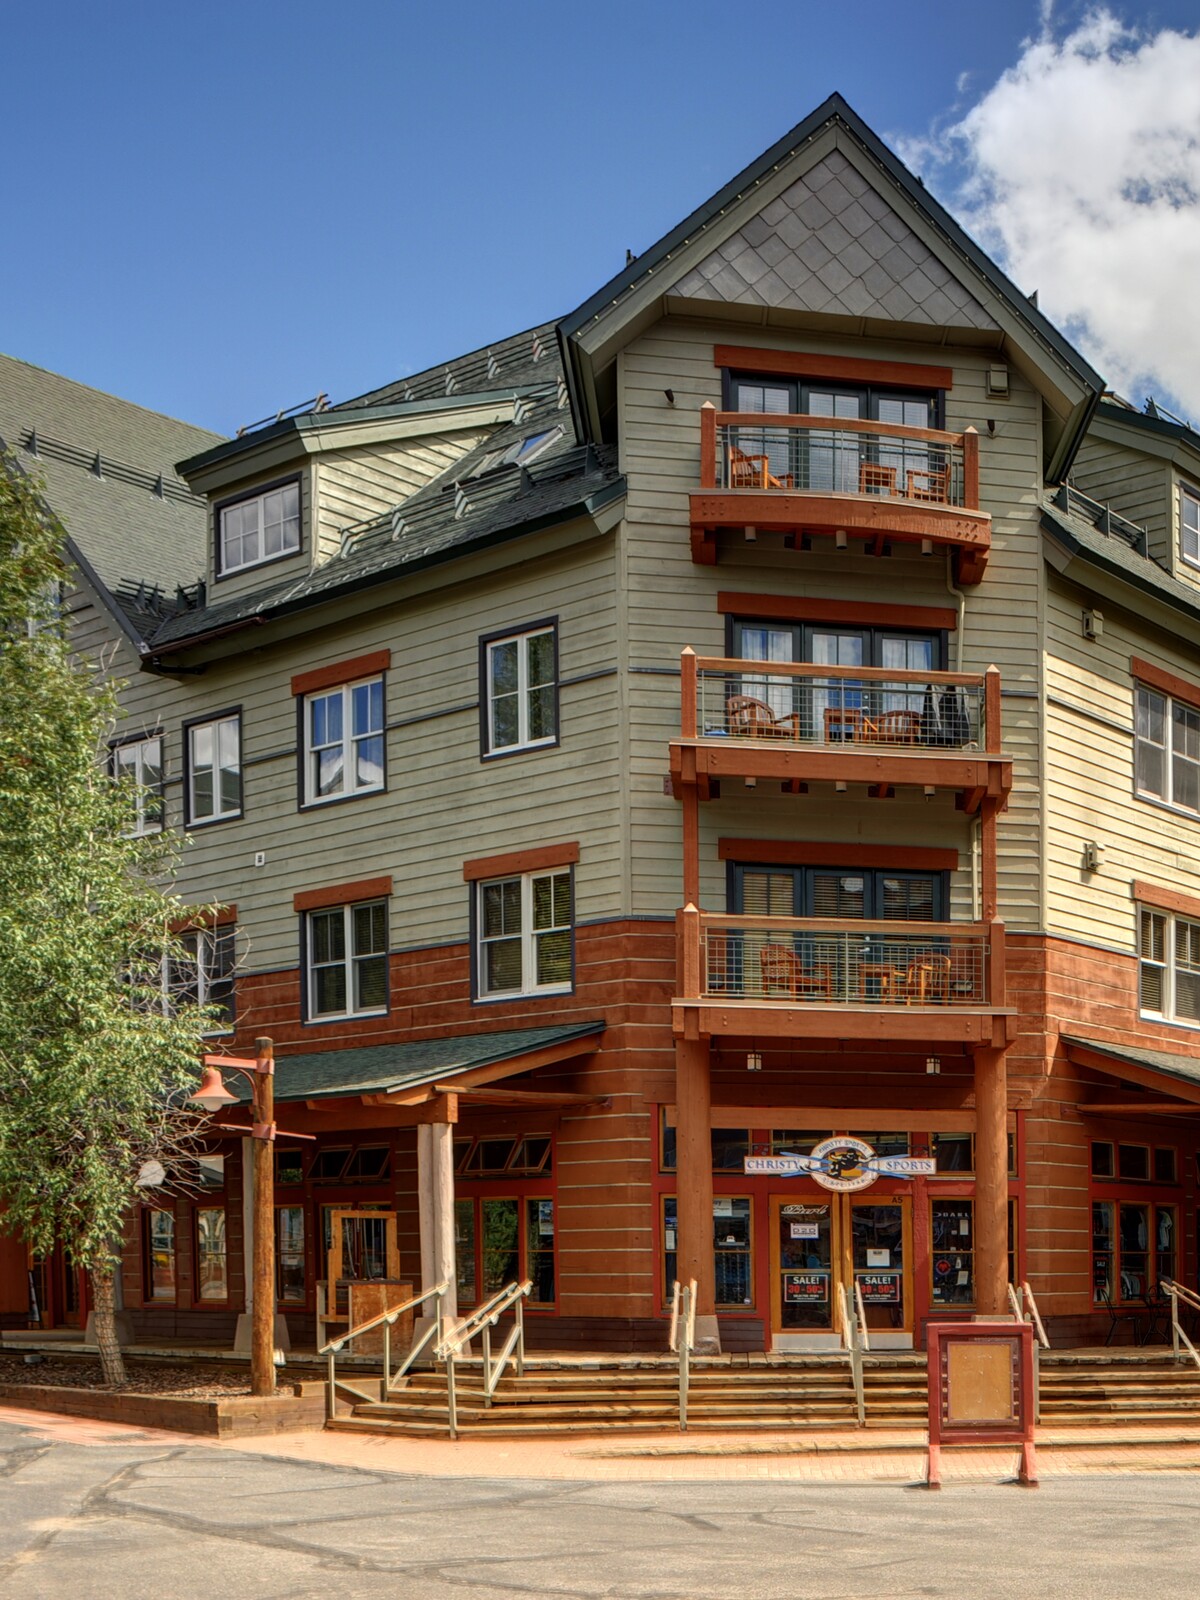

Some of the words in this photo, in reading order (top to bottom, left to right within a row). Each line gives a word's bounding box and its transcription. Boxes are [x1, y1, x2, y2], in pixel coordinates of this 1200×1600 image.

[747, 1160, 800, 1170] CHRISTY
[886, 1161, 932, 1171] SPORTS
[891, 1196, 903, 1204] A5
[793, 1276, 820, 1284] SALE!
[865, 1276, 891, 1284] SALE!
[788, 1284, 800, 1294] 30
